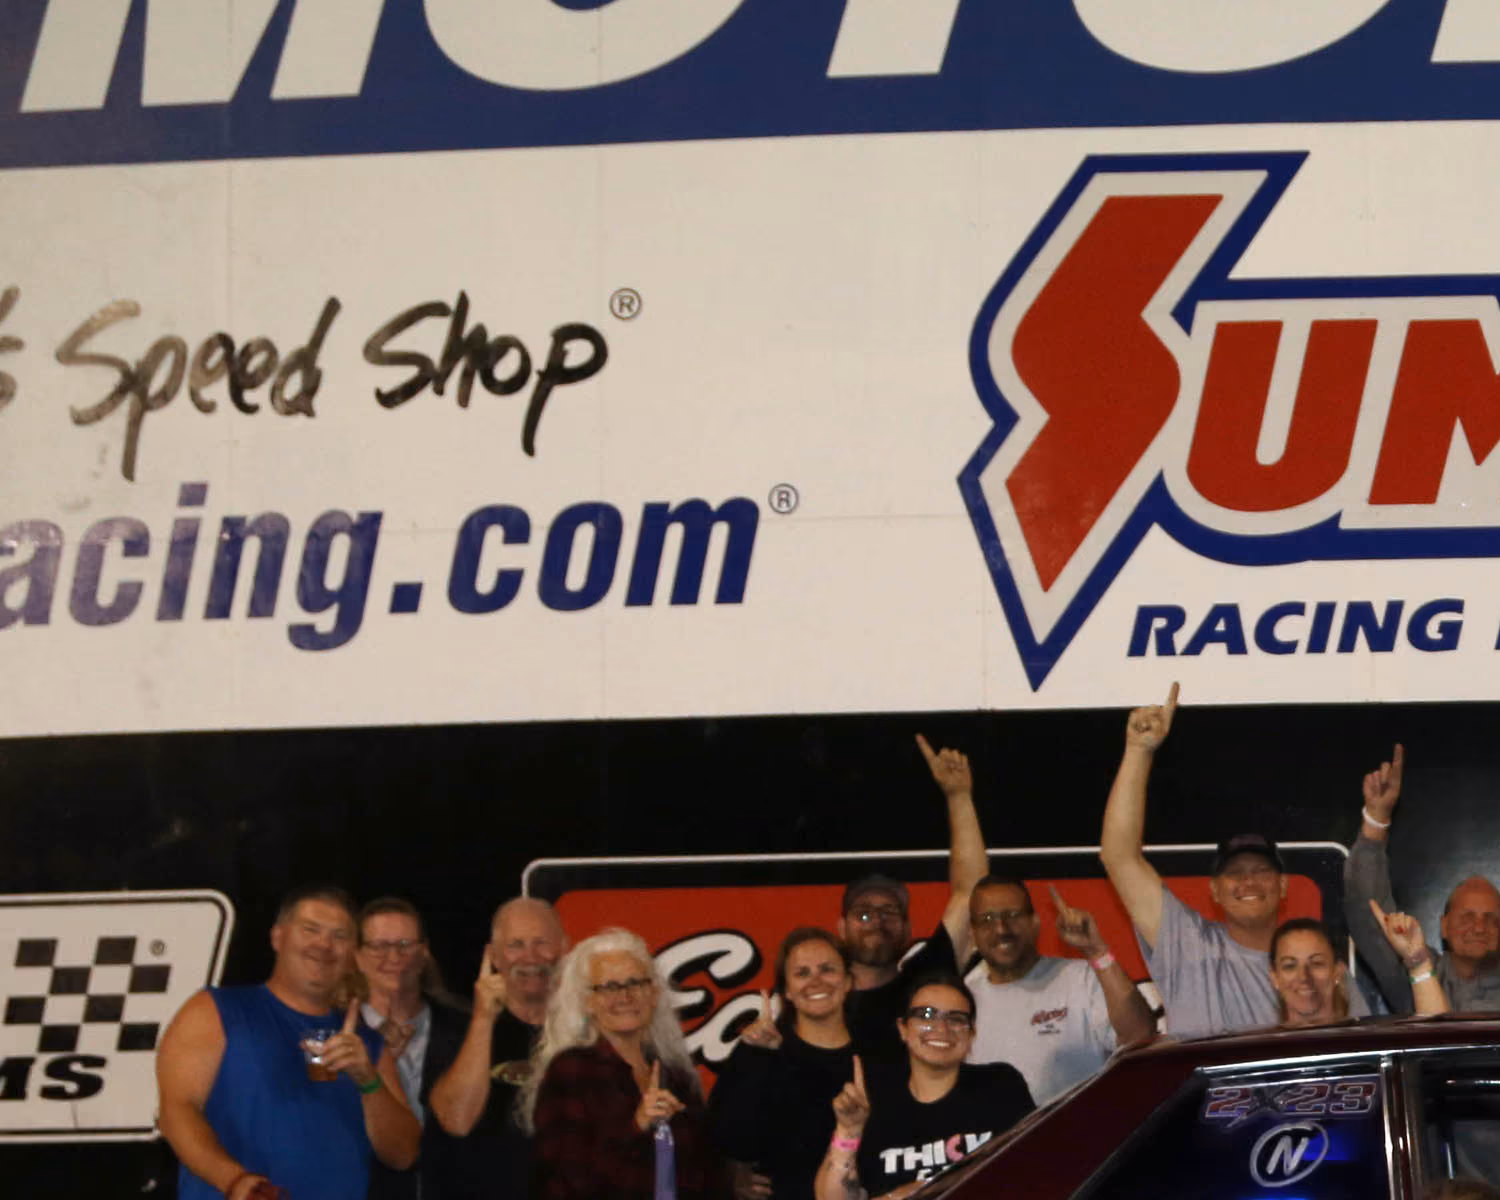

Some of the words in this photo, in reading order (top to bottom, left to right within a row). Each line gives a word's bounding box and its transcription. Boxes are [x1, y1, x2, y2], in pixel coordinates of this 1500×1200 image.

[55, 297, 342, 481] Speed
[362, 290, 609, 458] Shop
[1127, 599, 1464, 657] RACING
